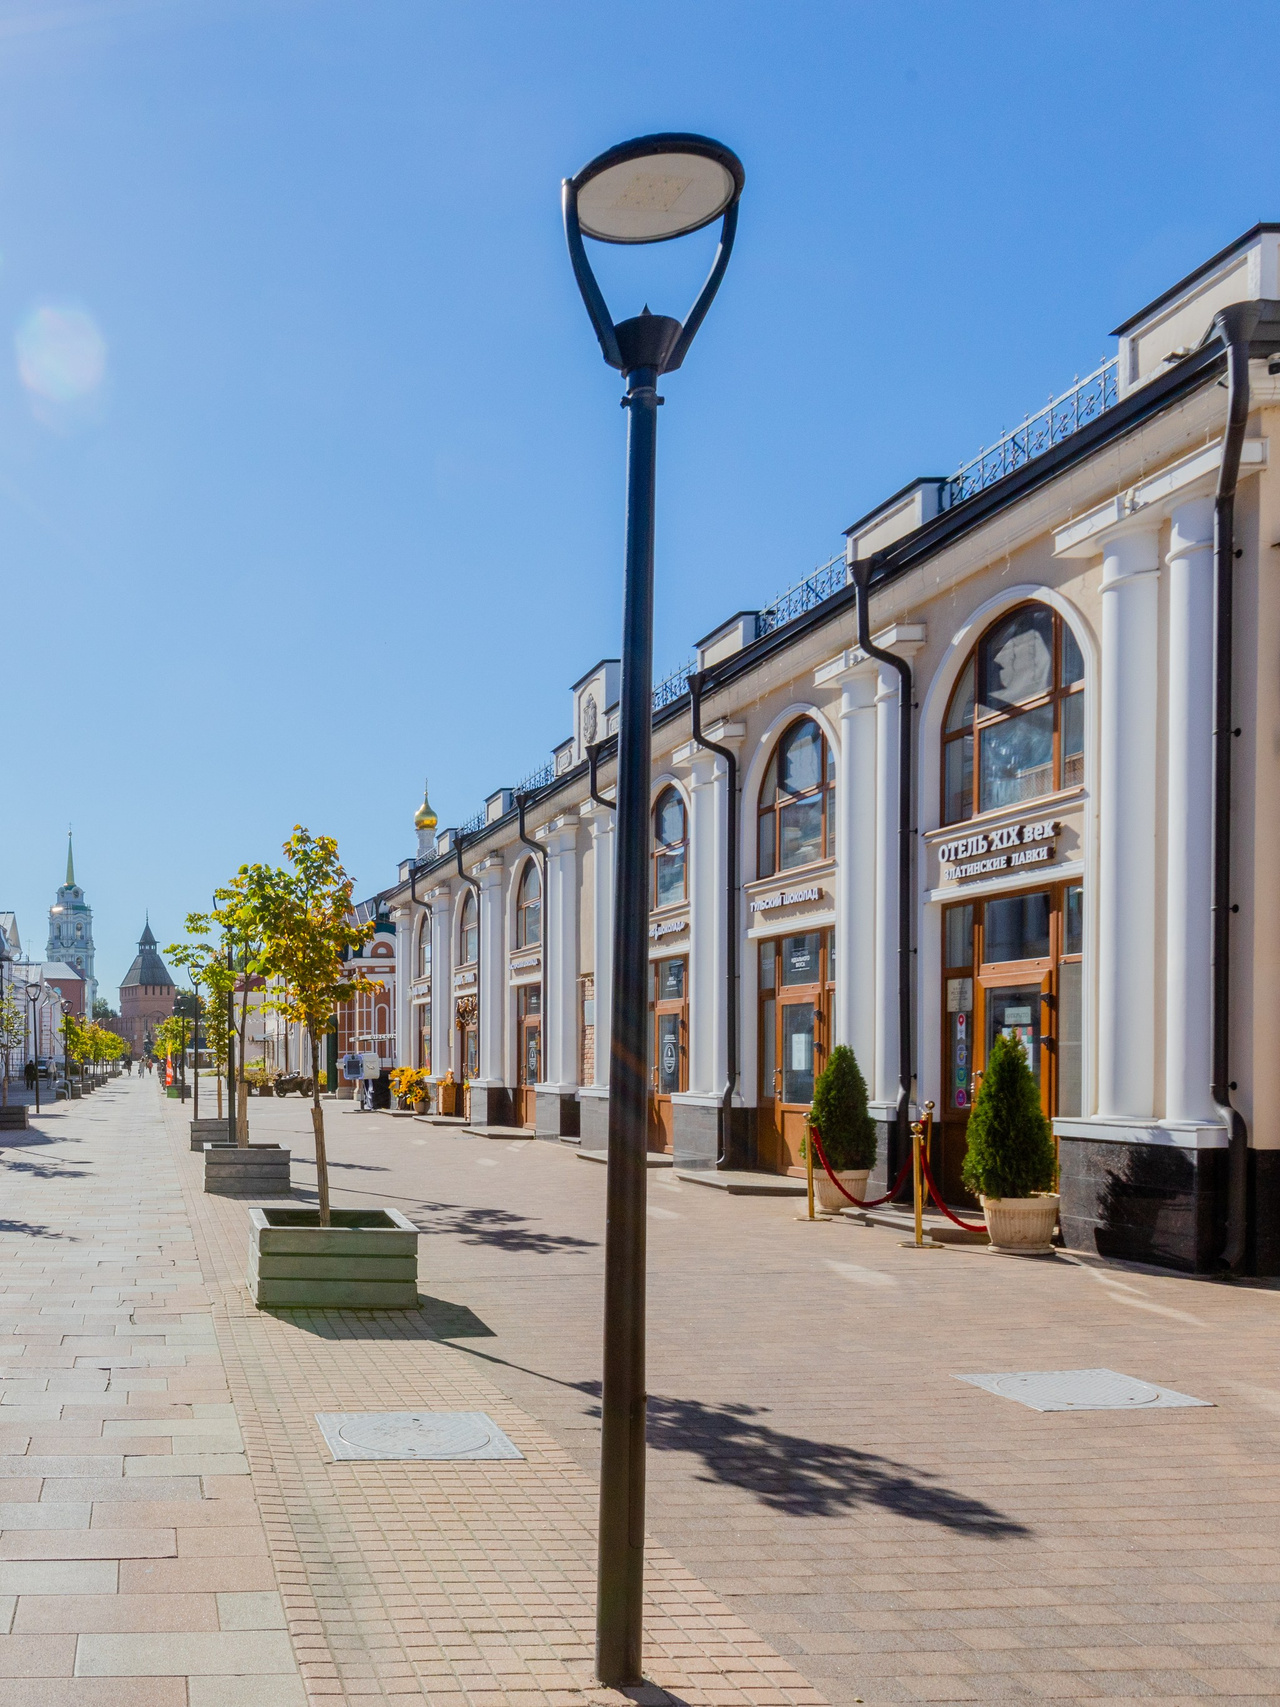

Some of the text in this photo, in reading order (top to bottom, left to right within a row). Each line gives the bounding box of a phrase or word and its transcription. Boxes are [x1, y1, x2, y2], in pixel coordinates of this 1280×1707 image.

[938, 821, 1056, 863] ОТЕЛЬ XIX век
[943, 846, 1049, 881] ЗЛАТИНСКИЕ ЛАВКИ
[750, 887, 819, 913] ТУЛЬСКИЙ ШОКОЛАД
